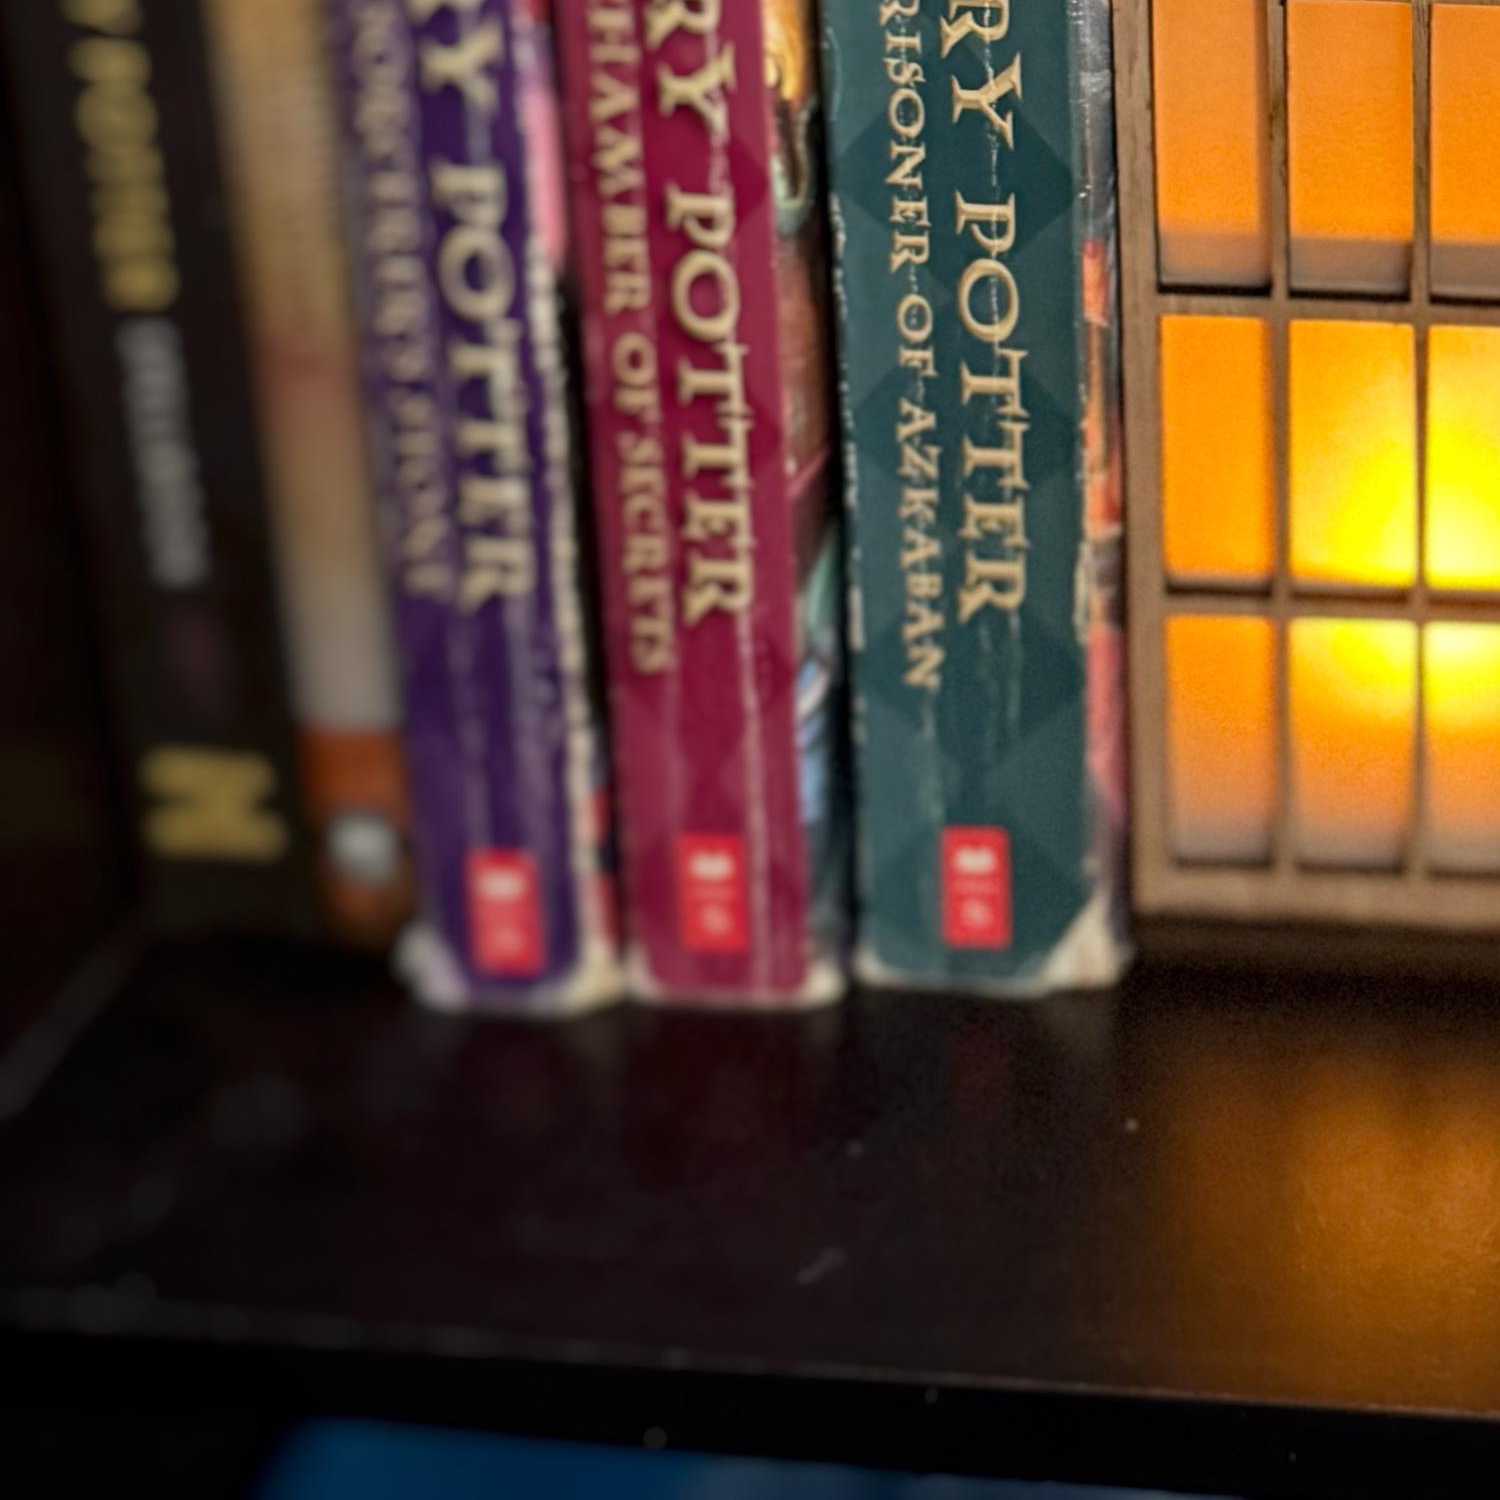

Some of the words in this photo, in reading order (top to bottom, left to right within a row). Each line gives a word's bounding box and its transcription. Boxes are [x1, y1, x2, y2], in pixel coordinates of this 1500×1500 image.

[432, 160, 535, 612] POTTER
[612, 332, 662, 415] OF
[667, 183, 756, 626] POTTER
[896, 295, 935, 377] OF
[956, 190, 1031, 624] POTTER
[614, 428, 679, 675] SECRETS
[893, 398, 945, 690] AZKABAN
